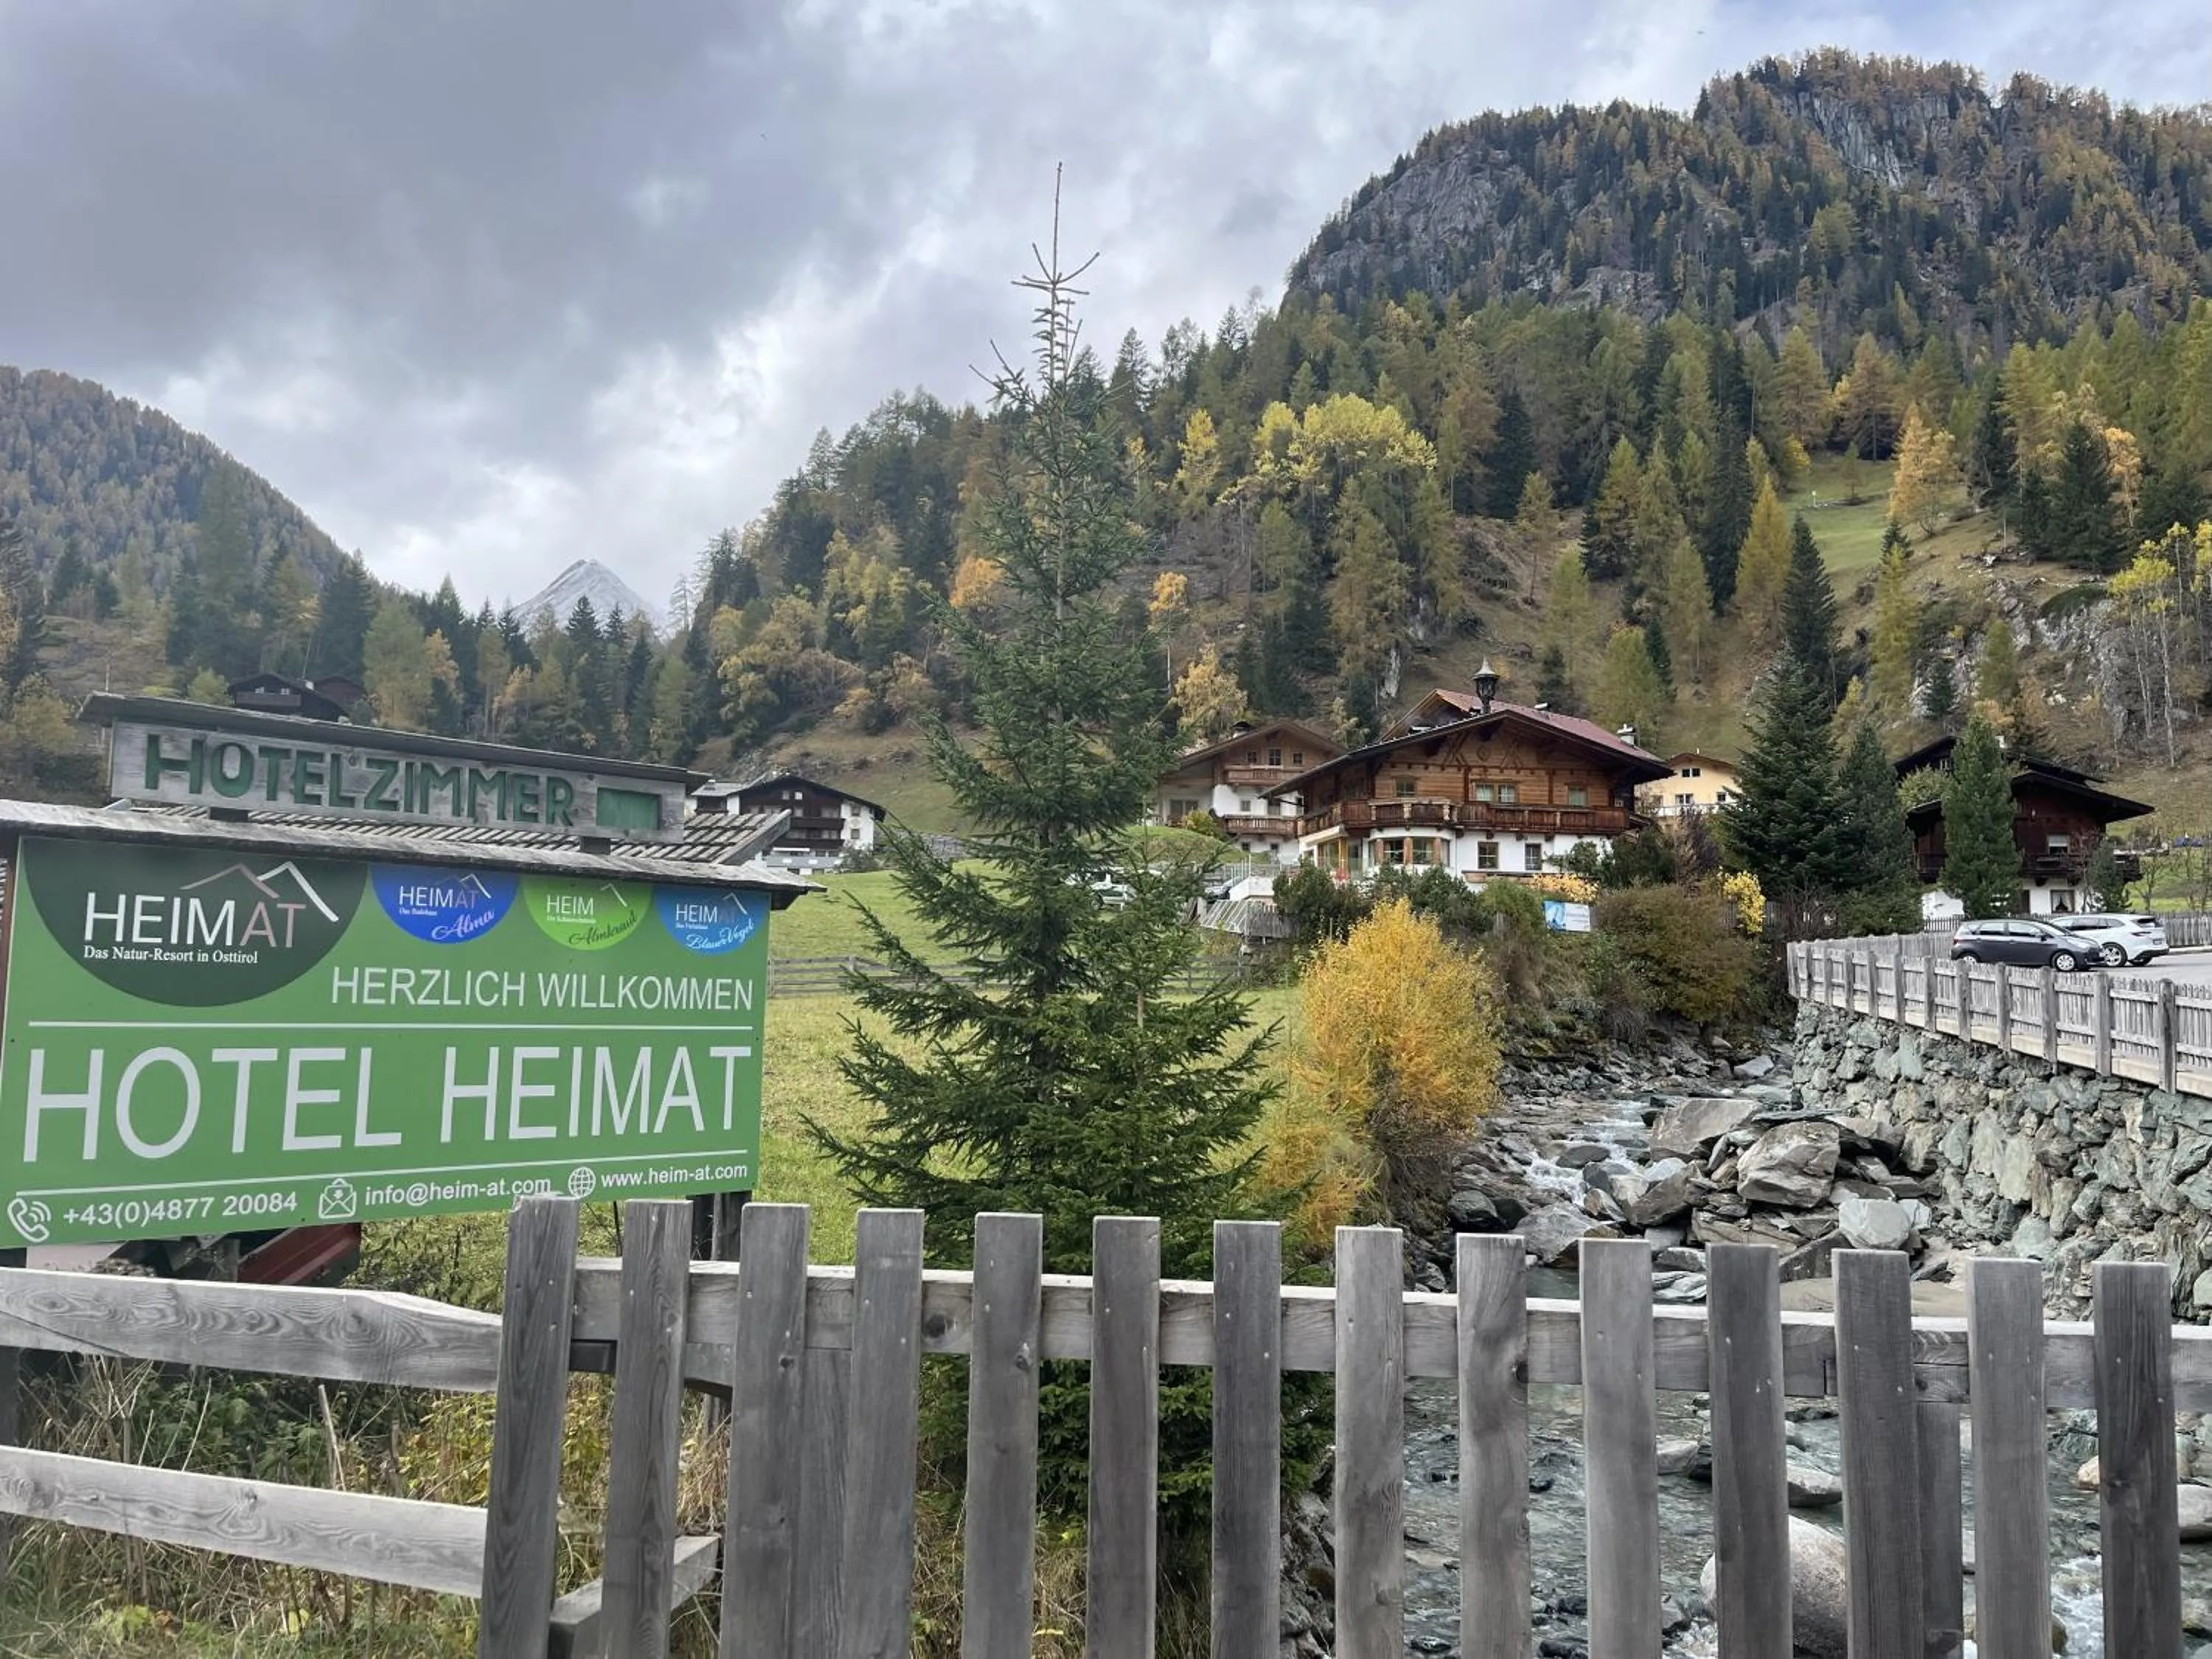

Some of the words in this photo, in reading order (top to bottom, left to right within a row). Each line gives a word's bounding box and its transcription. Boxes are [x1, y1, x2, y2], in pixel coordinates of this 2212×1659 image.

[144, 732, 577, 828] HOTELZIMMER
[399, 886, 479, 909] HEIMAT
[83, 892, 307, 948] HEIMAT
[431, 908, 495, 940] Alma
[83, 945, 108, 959] Das
[112, 946, 194, 962] Natur-Resort
[197, 949, 209, 962] in
[212, 949, 258, 964] Osttirol
[331, 967, 526, 1007] HERZLICH
[538, 972, 754, 1011] WILLKOMMEN
[23, 1046, 403, 1163] HOTEL
[440, 1046, 752, 1143] HEIMAT
[365, 1178, 552, 1207] info@heim-at.com
[601, 1164, 748, 1188] www.heim-at.com
[63, 1197, 215, 1229] +43(0)4877
[222, 1191, 298, 1217] 20084
